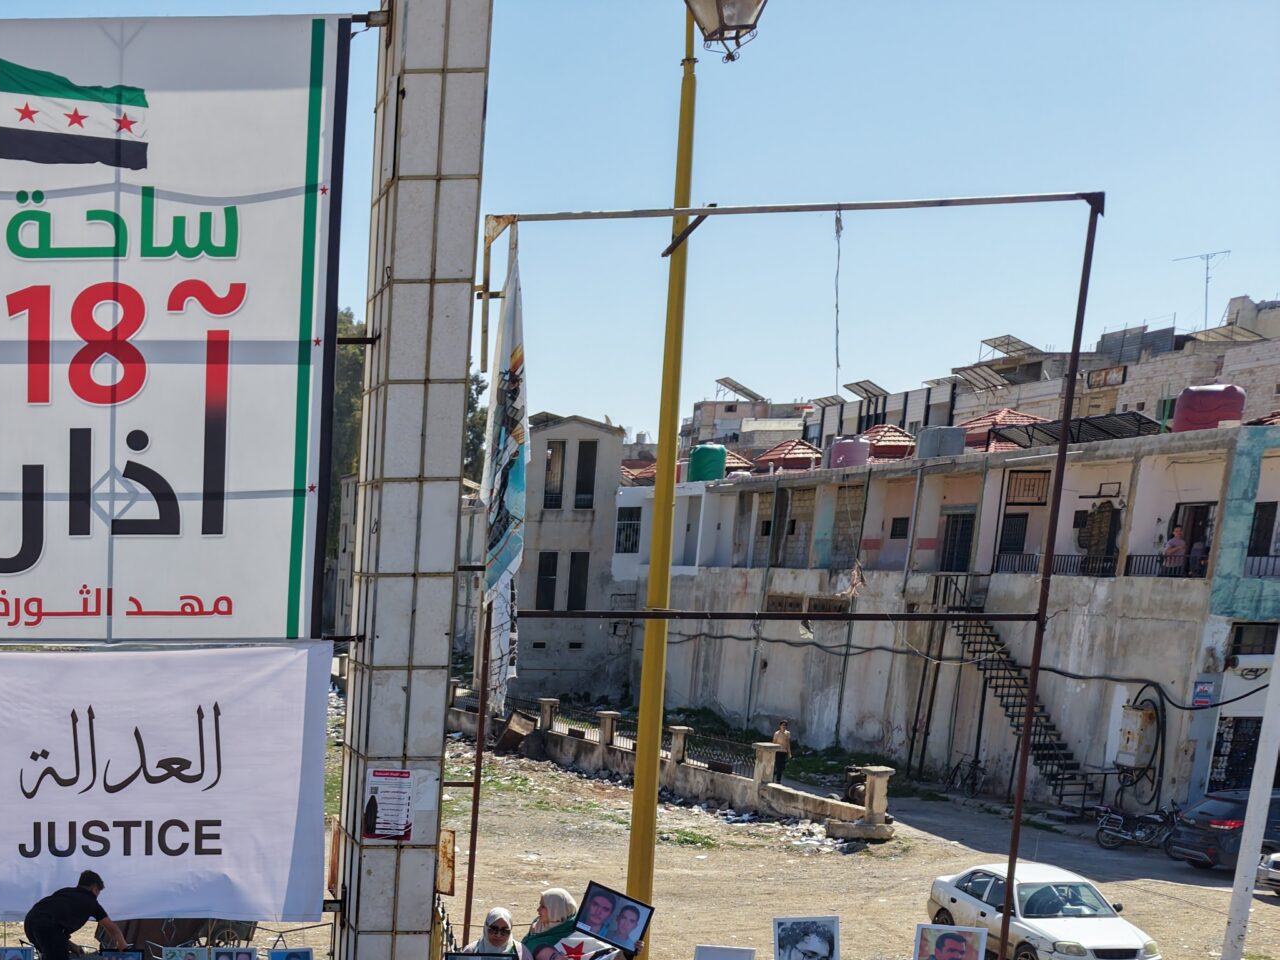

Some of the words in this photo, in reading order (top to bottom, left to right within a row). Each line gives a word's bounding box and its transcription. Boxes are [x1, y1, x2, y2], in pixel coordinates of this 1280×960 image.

[6, 186, 239, 259] ساحة
[6, 281, 148, 405] 18
[126, 595, 234, 617] مهد
[19, 701, 222, 800] العدالة
[18, 819, 222, 859] JUSTICE
